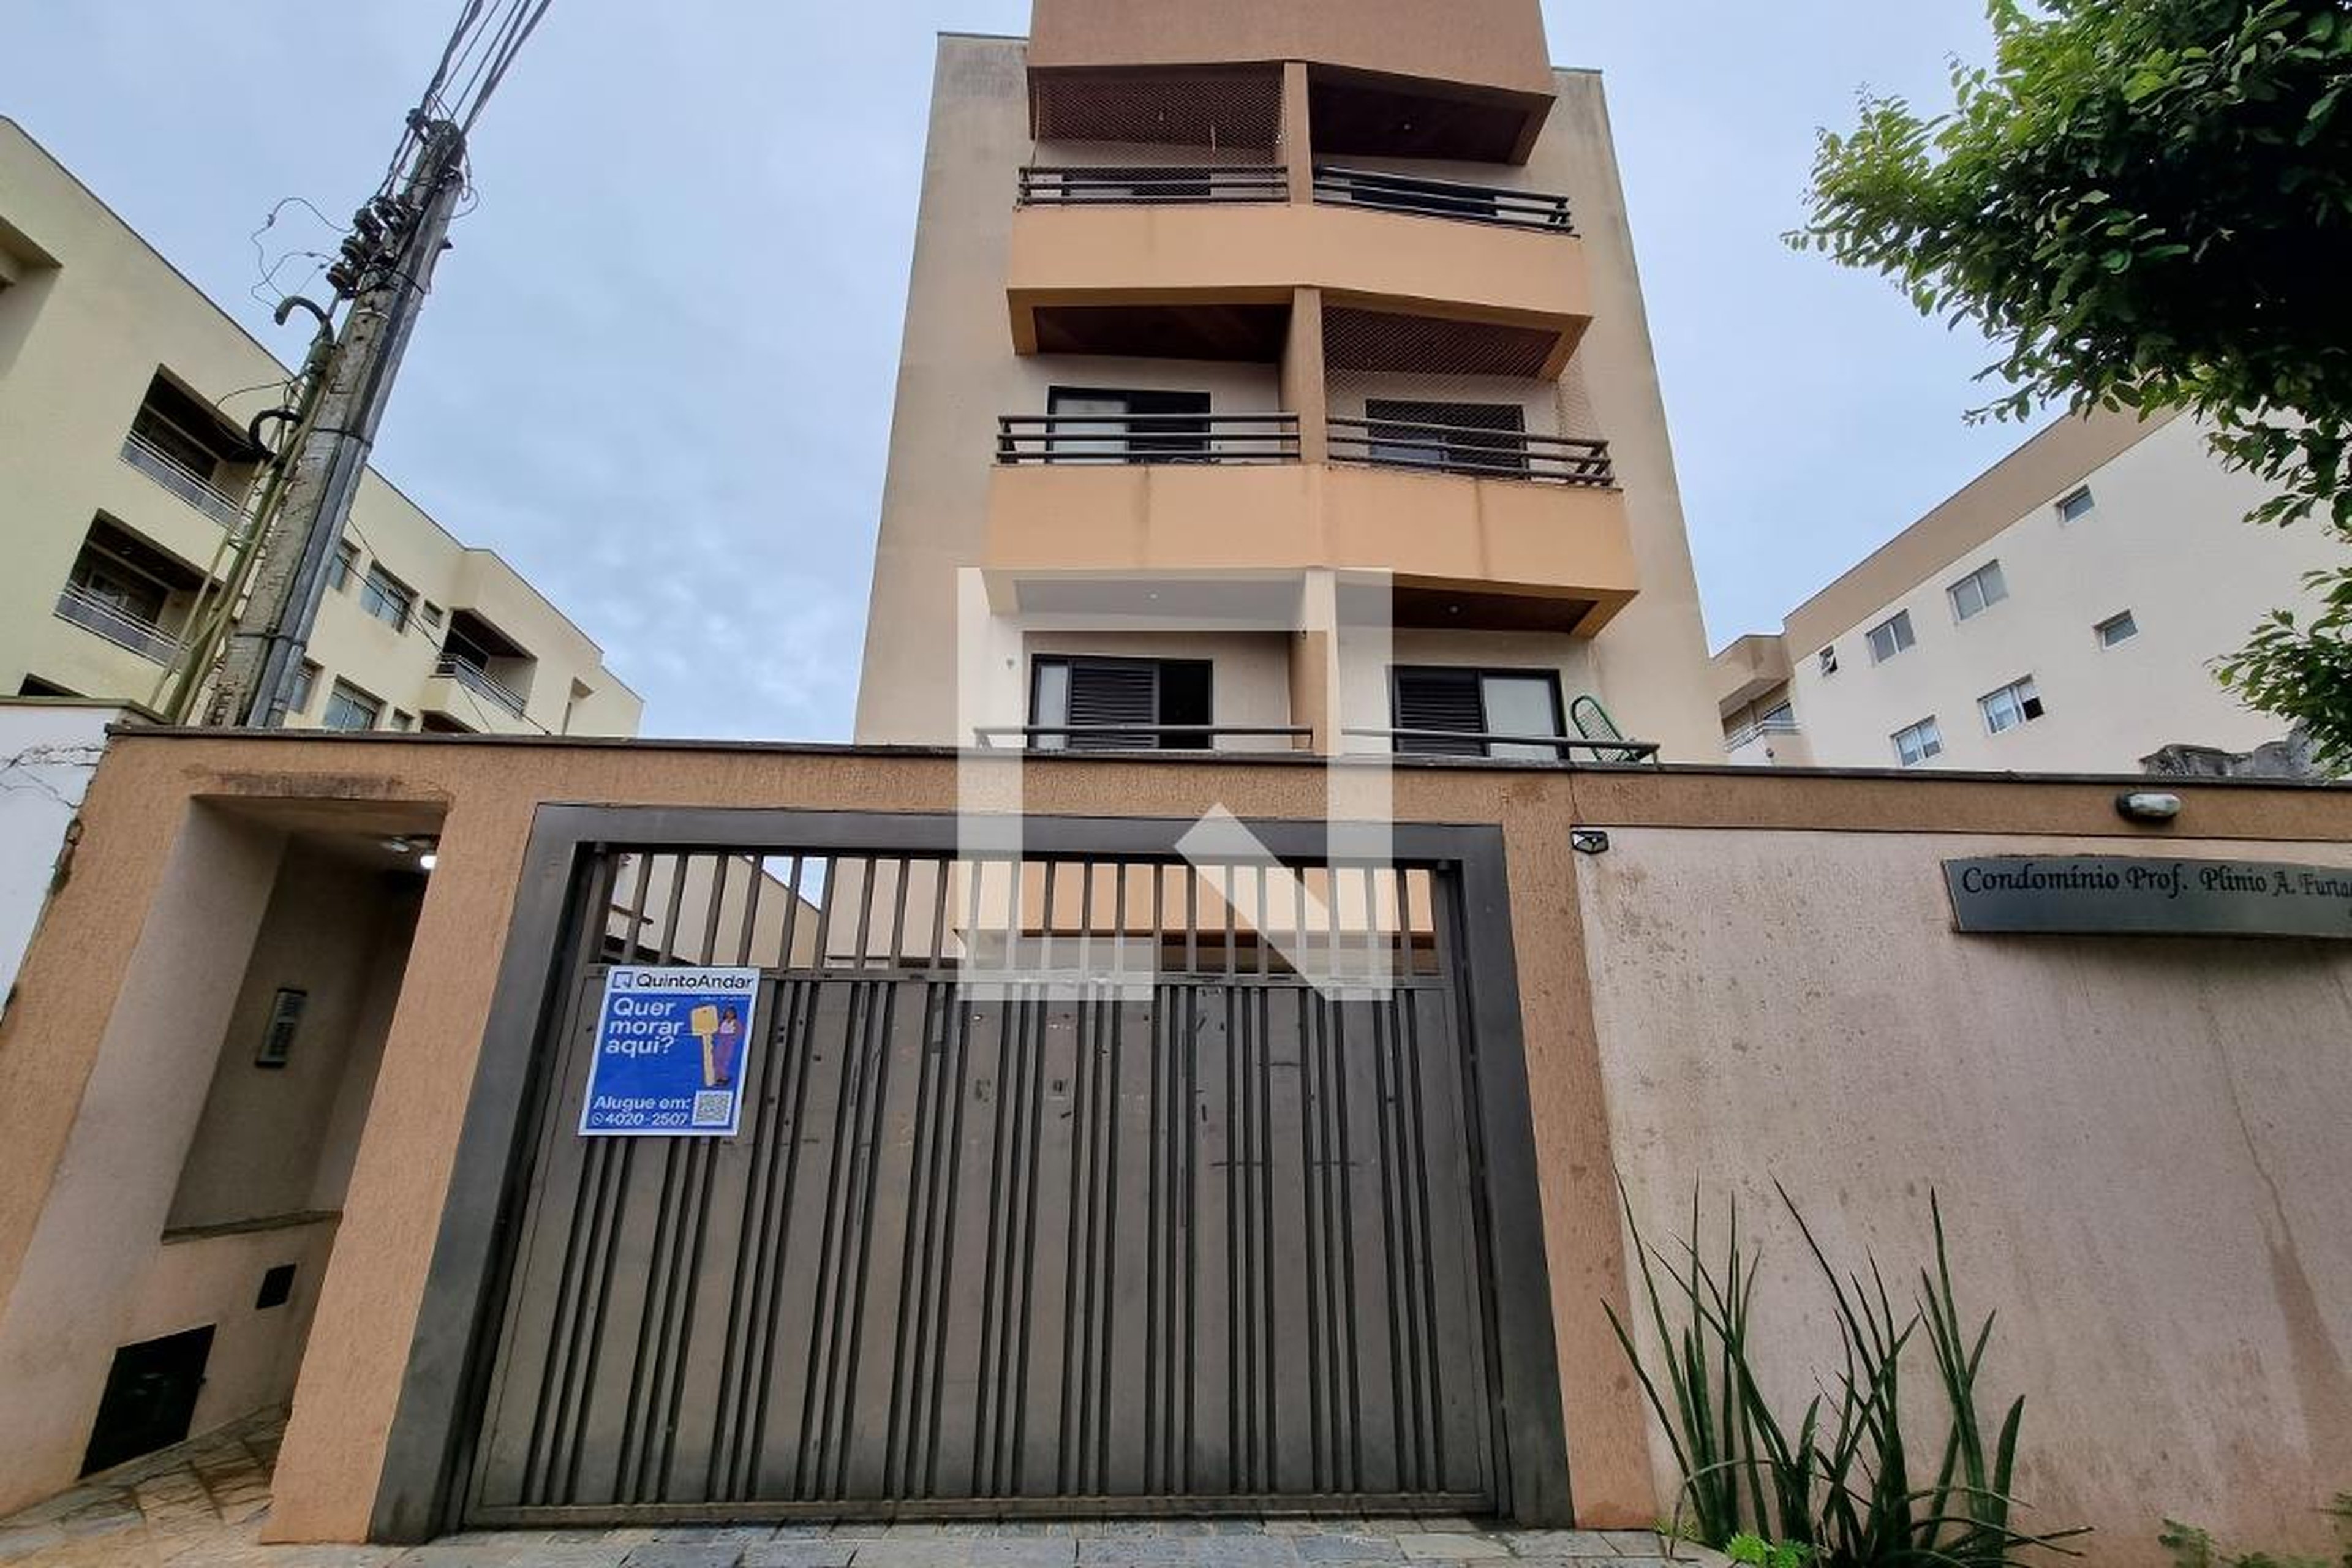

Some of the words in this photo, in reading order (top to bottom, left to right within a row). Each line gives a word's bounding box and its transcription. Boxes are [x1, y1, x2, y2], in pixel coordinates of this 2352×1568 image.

[1962, 863, 2120, 893] Condomínio
[2125, 863, 2188, 899] Prof.
[2272, 870, 2296, 897] A.
[2299, 873, 2352, 898] Furta
[636, 974, 755, 989] QuintoAndar
[613, 997, 676, 1016] Quer
[609, 1020, 684, 1036] morar
[605, 1036, 674, 1058] aqui?
[593, 1096, 655, 1113] Alugue
[658, 1098, 690, 1110] em:
